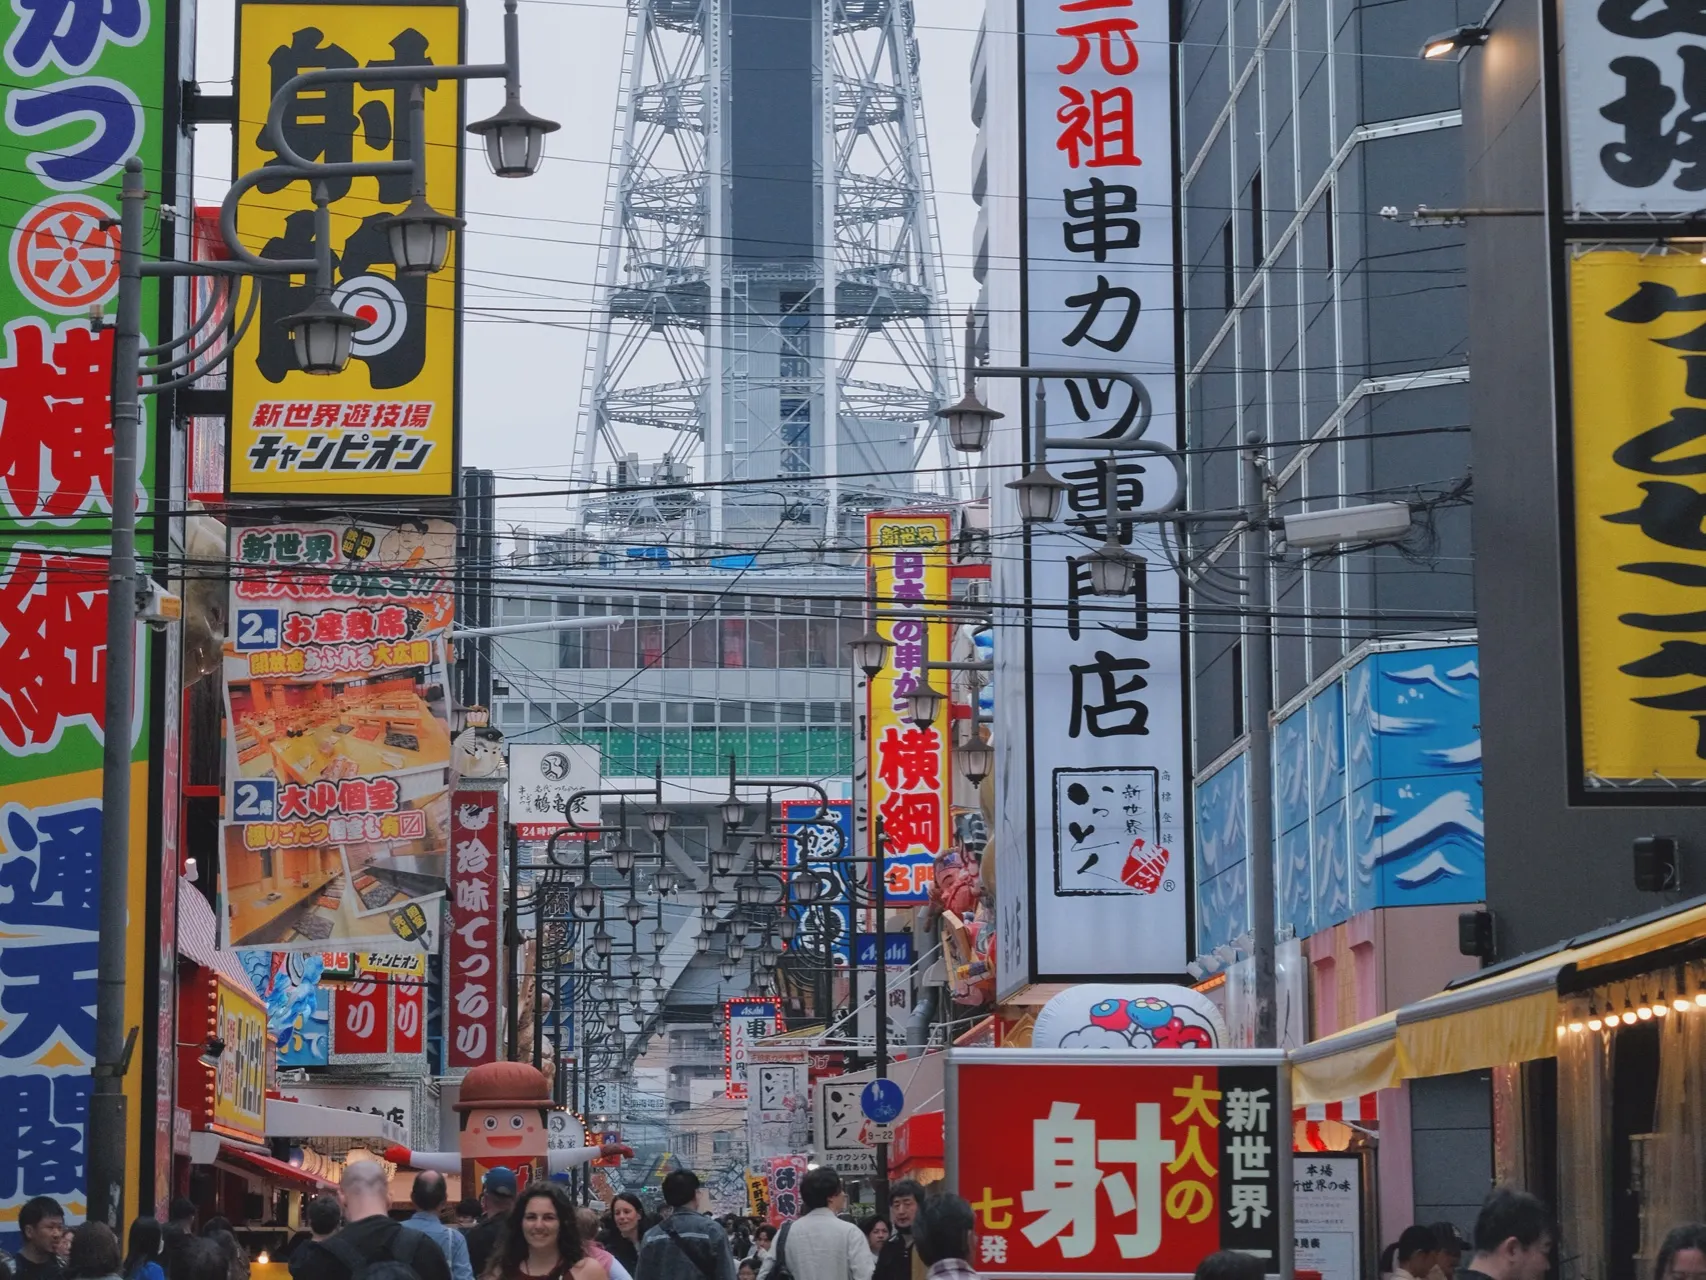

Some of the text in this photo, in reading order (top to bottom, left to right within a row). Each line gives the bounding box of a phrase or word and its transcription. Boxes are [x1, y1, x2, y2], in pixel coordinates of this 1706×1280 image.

[251, 401, 432, 429] 新世界遊技場
[249, 433, 434, 471] チャンピオン
[241, 532, 335, 563] 新世界
[279, 778, 398, 818] 大小個室
[878, 727, 941, 855] 横綱
[368, 951, 420, 970] チャンピオン
[861, 942, 908, 961] Aahi
[740, 1005, 765, 1016] Asahi
[1163, 1074, 1223, 1223] 大人の
[1021, 1101, 1177, 1259] 射
